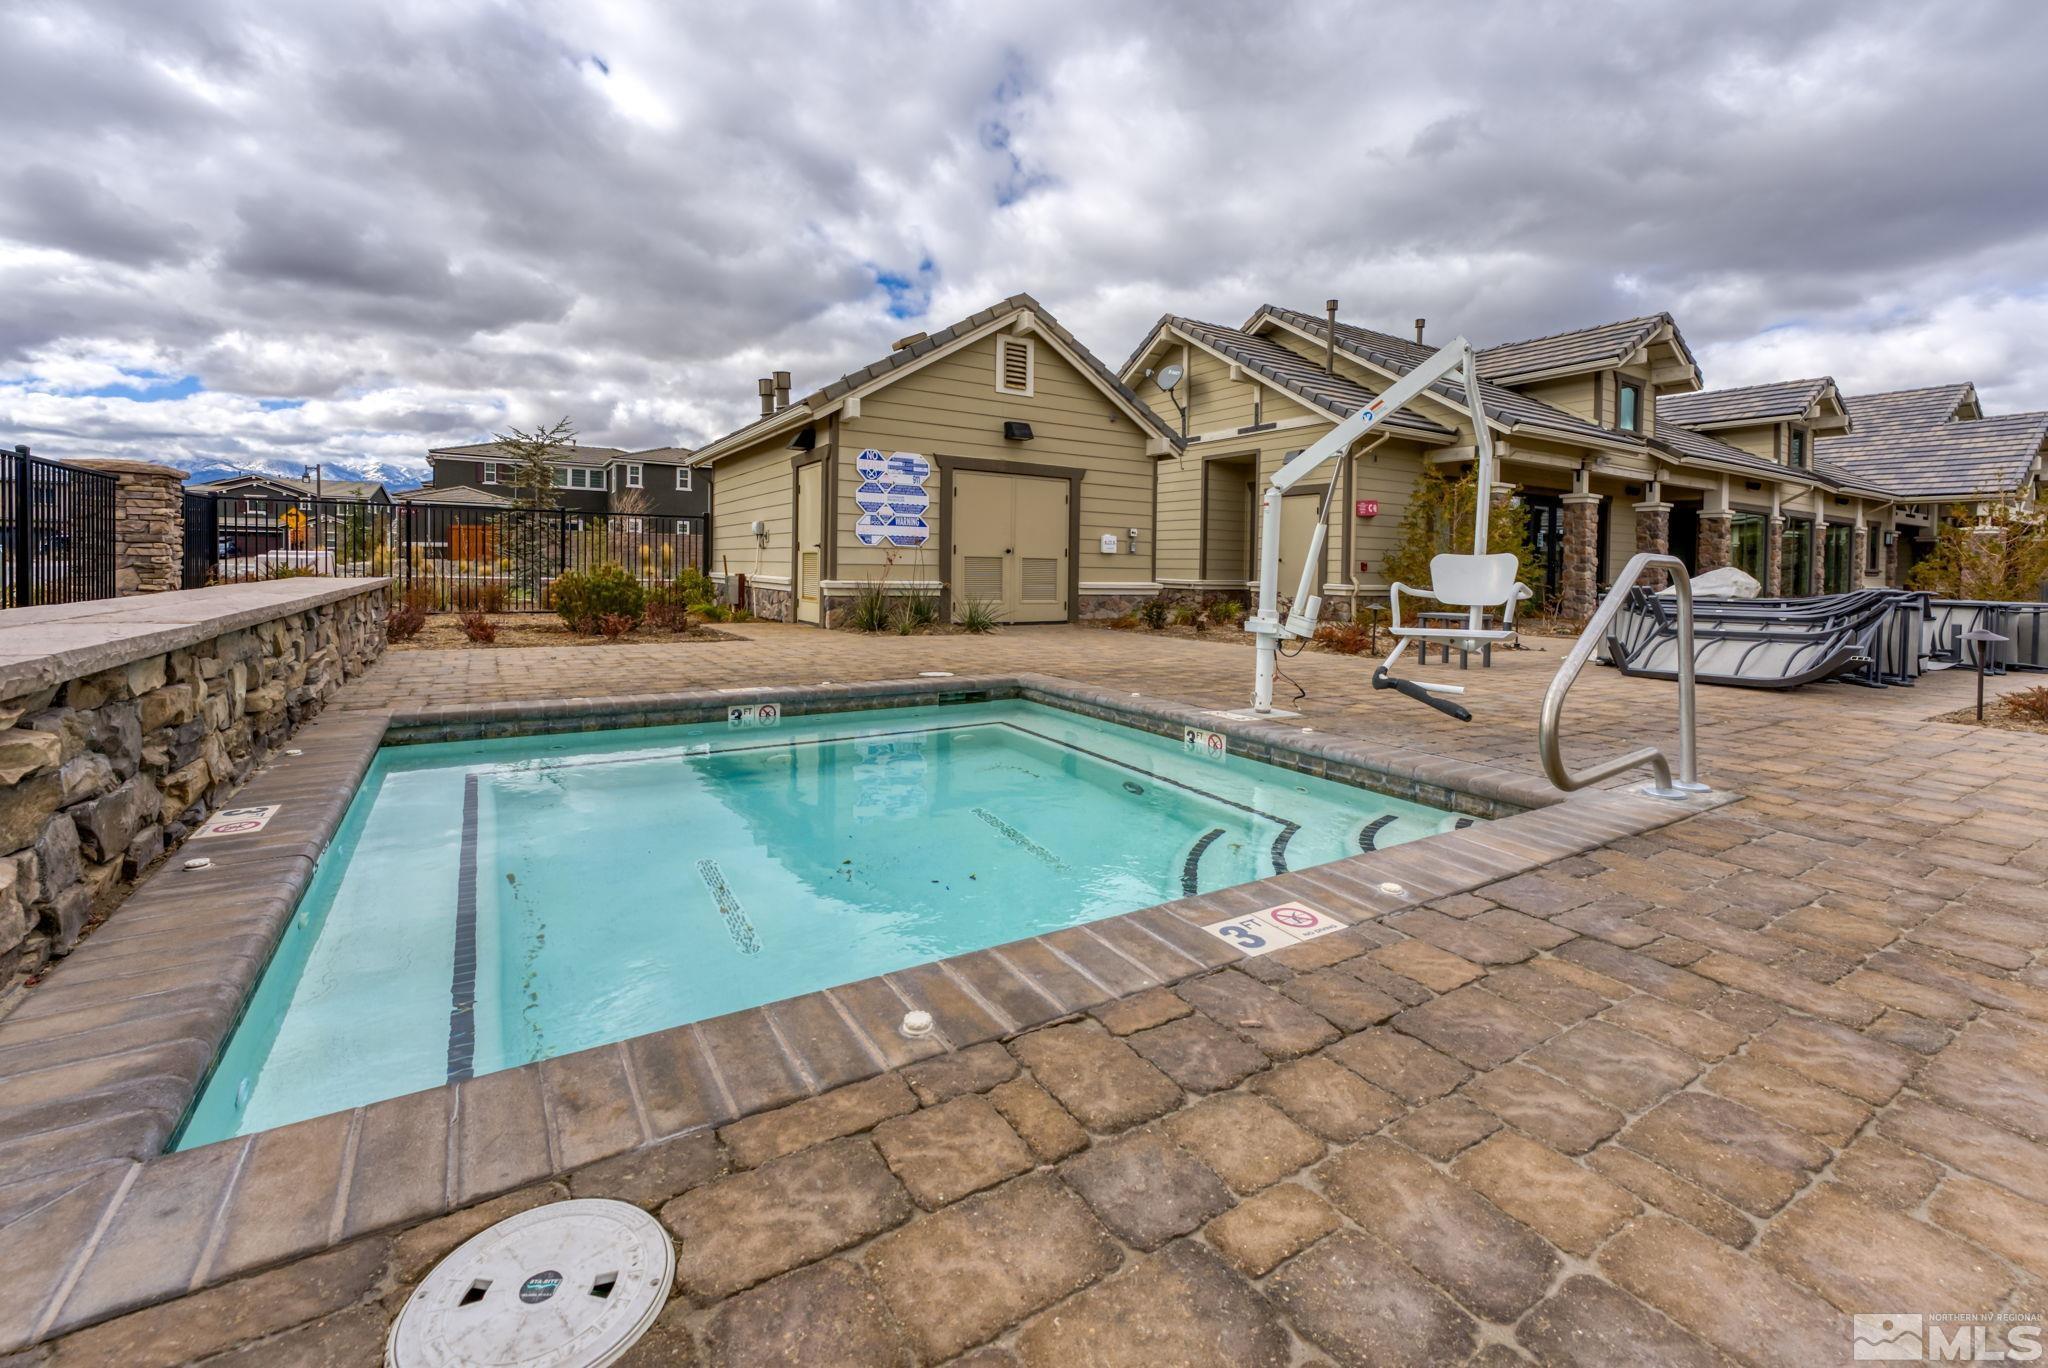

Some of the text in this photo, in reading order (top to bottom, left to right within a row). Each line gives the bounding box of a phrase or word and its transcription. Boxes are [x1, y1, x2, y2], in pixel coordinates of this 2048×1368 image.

[866, 450, 878, 460] NO
[912, 475, 921, 485] 911
[896, 516, 920, 527] WARNING
[1219, 919, 1267, 949] 3 FT
